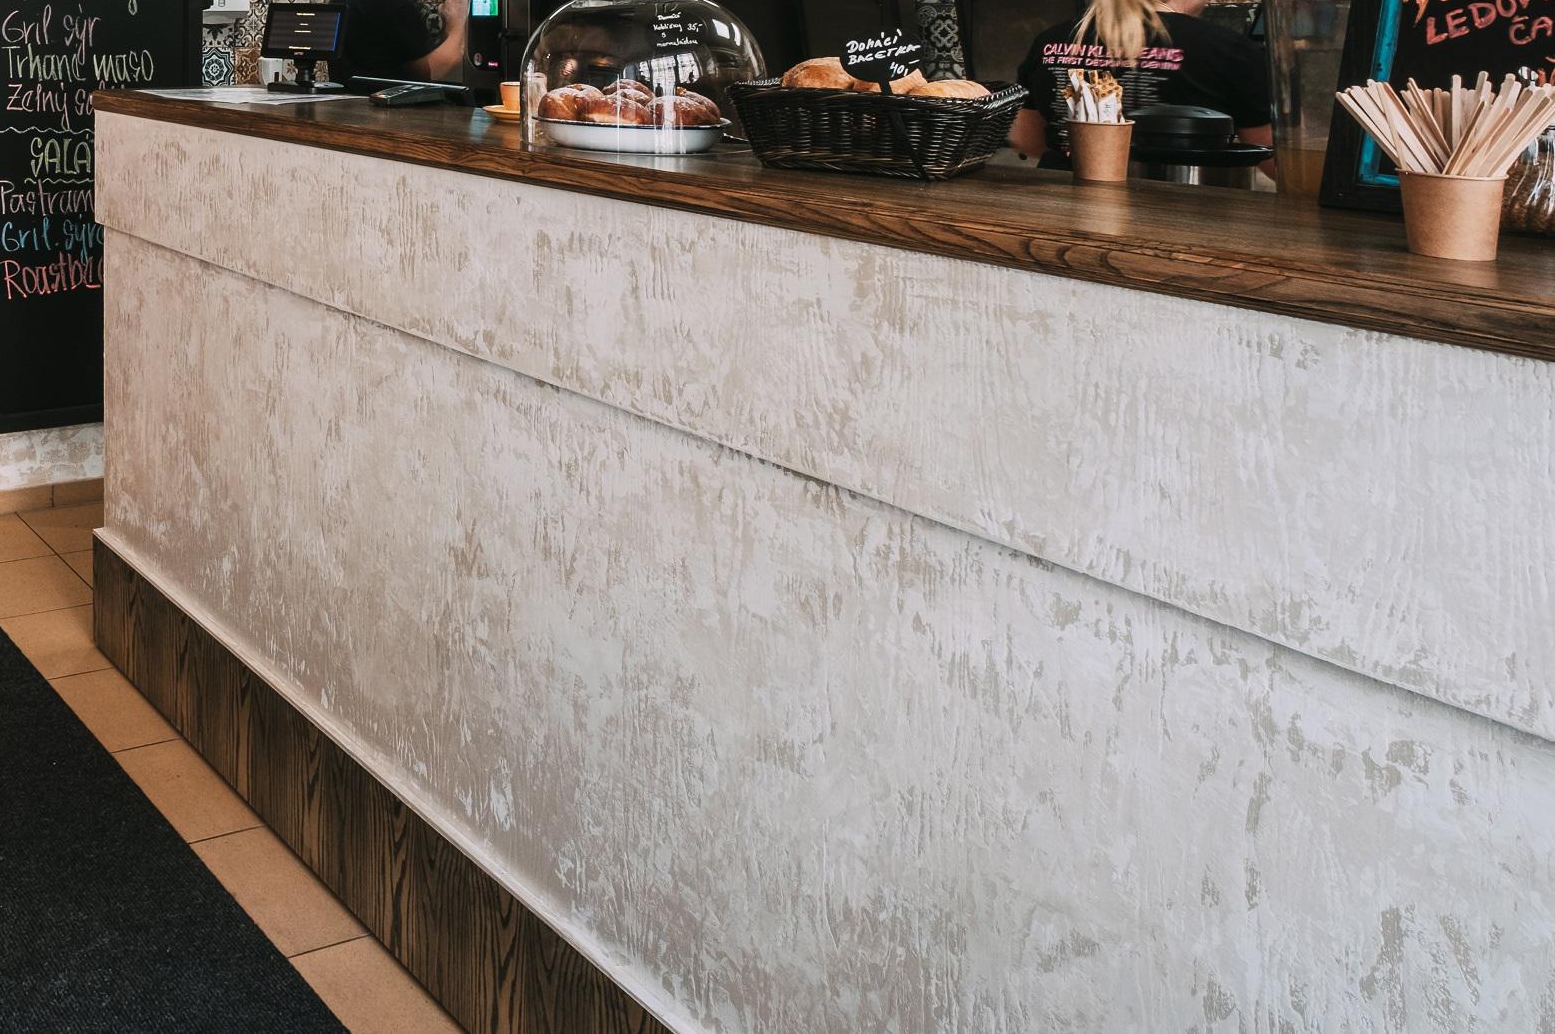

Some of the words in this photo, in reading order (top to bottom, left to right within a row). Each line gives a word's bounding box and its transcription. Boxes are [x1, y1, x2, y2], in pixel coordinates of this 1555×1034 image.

[63, 3, 102, 66] sýr
[93, 49, 154, 84] maso
[1043, 56, 1055, 64] THE
